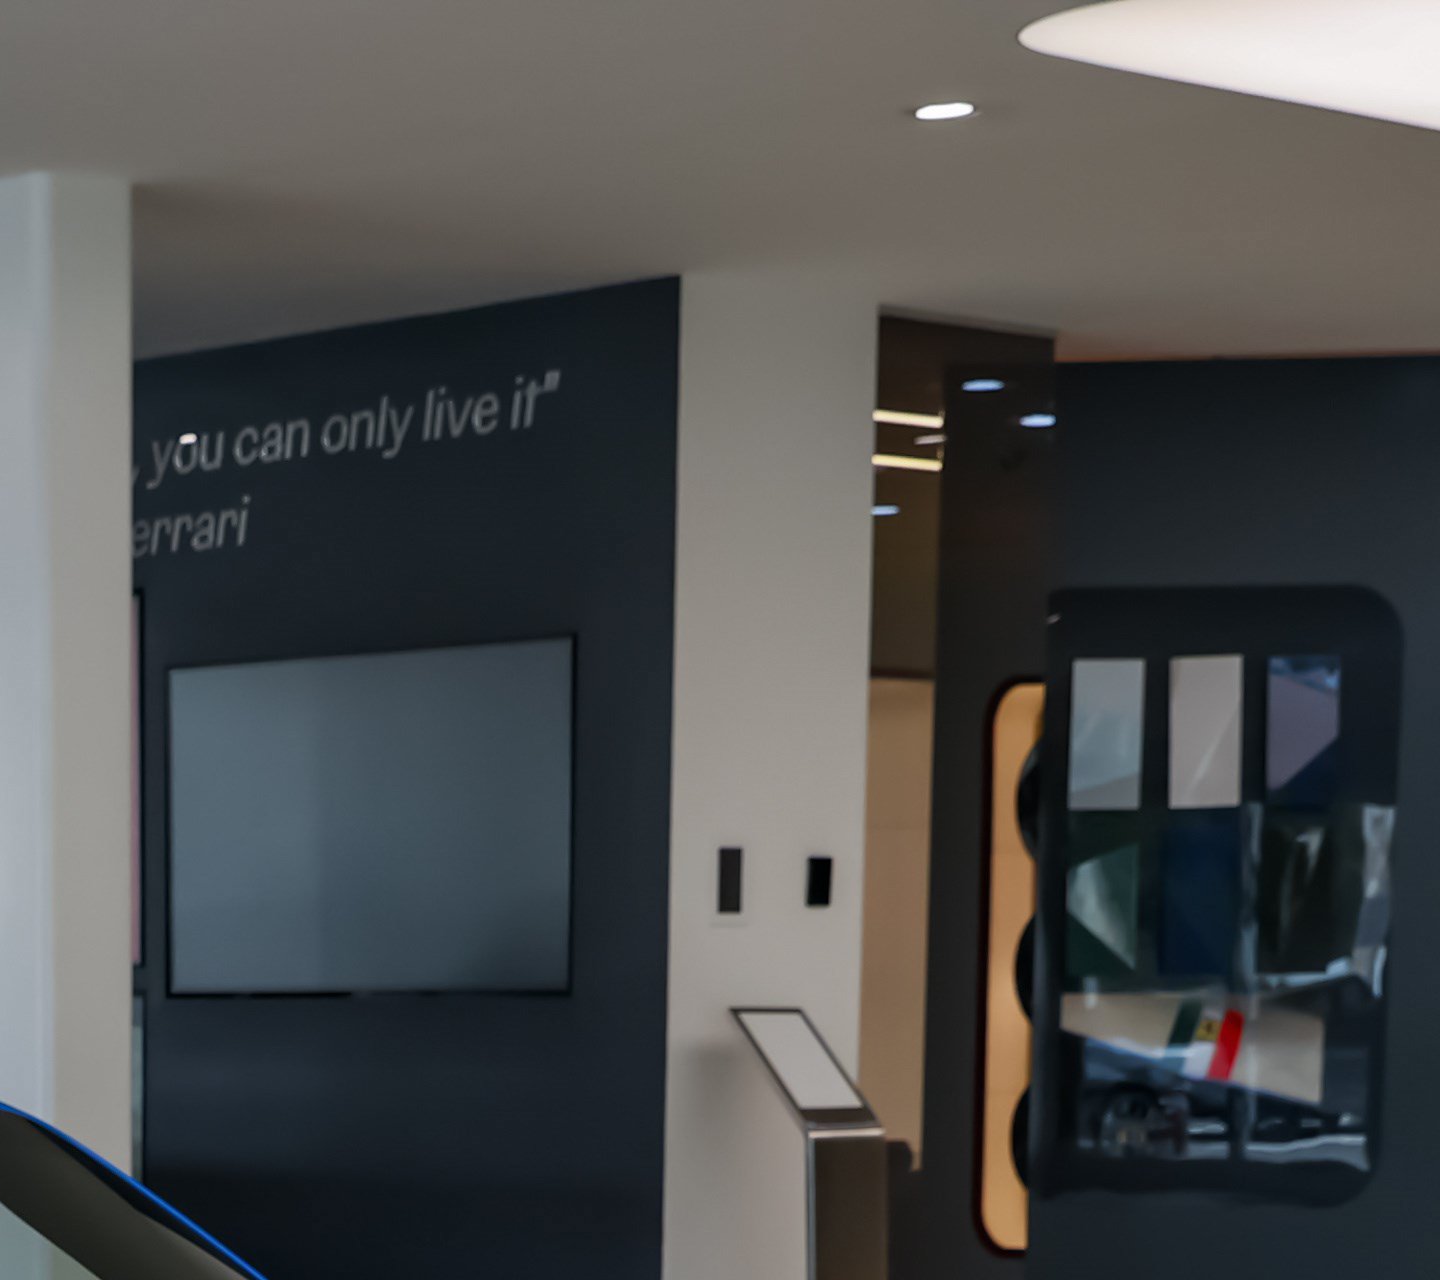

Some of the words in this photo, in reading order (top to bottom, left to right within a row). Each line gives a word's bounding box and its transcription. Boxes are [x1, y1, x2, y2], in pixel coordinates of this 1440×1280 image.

[146, 430, 224, 491] you
[233, 418, 311, 467] can
[319, 394, 415, 460] only
[421, 384, 499, 442] live
[132, 494, 252, 559] errari
